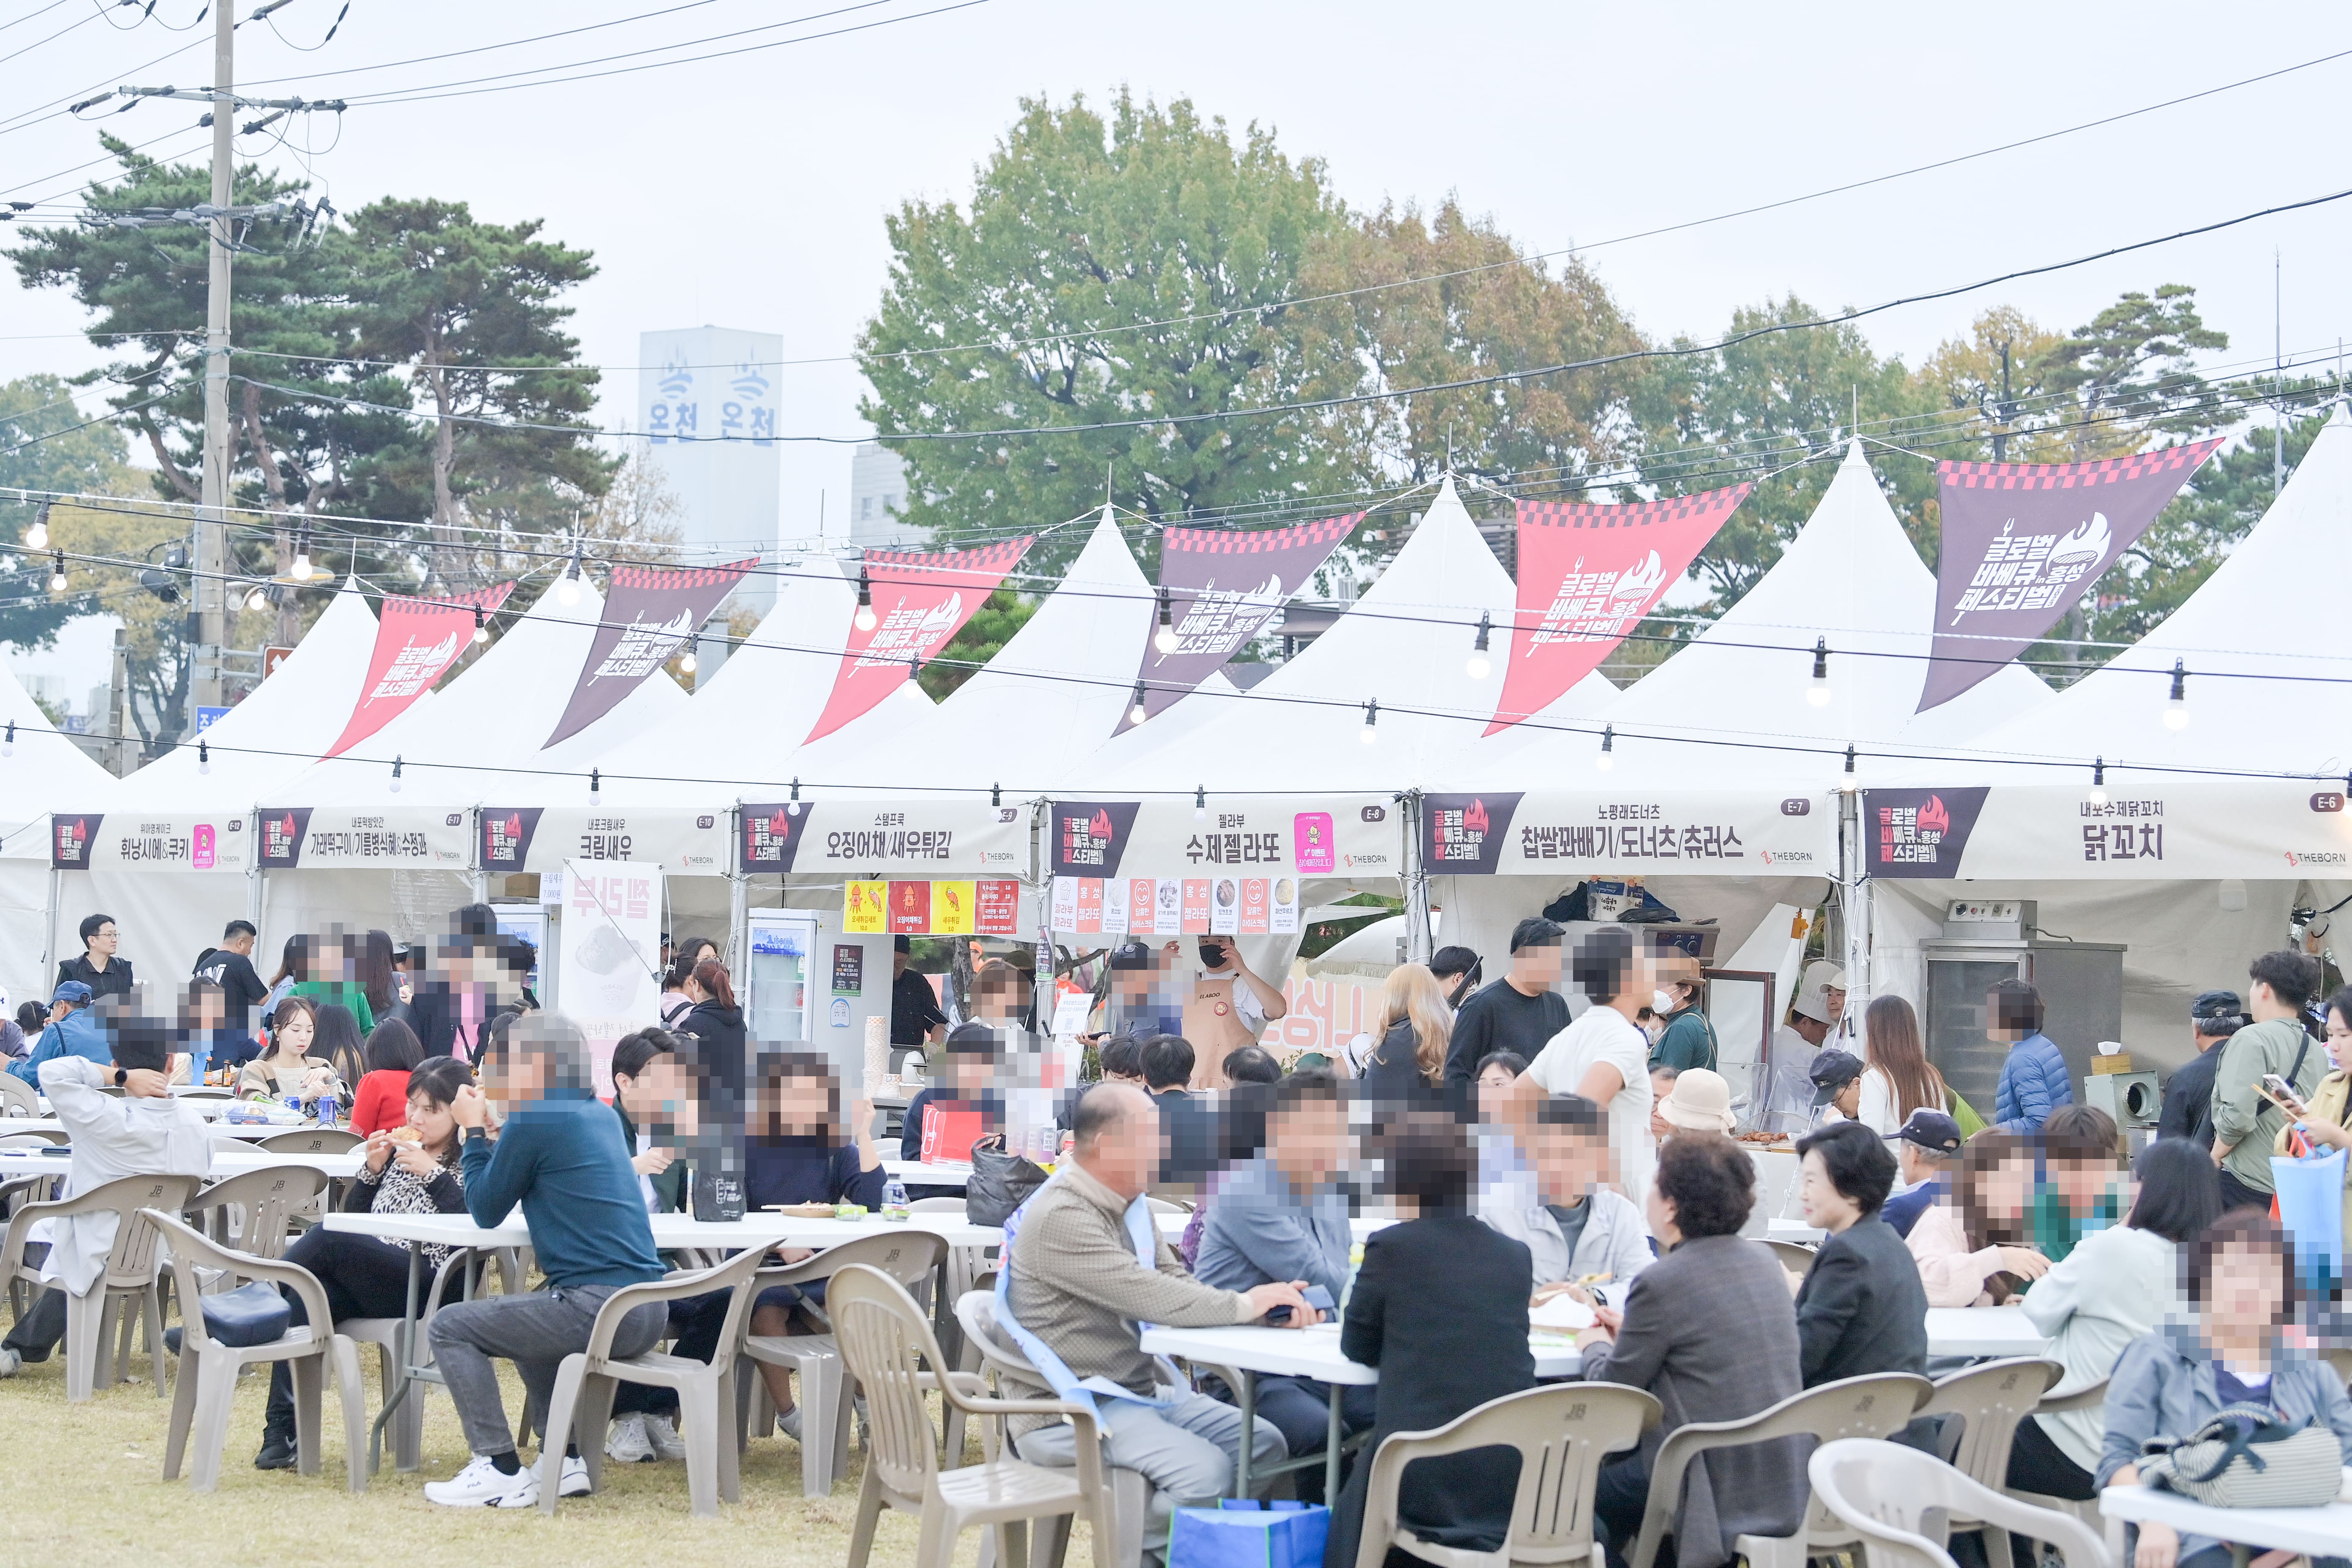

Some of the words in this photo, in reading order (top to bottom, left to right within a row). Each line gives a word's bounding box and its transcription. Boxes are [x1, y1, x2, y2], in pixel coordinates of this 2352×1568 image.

[650, 403, 697, 444] 온천
[721, 401, 774, 447] 온천
[1984, 534, 2058, 562] 글로벌
[1970, 561, 2043, 587] 바베큐
[2045, 563, 2087, 585] 홍성
[1557, 571, 1619, 597] 글로벌
[1188, 593, 1242, 615] 글로벌
[1954, 585, 2054, 612] 페스티벌
[1544, 597, 1607, 620] 바베큐
[1607, 600, 1643, 619] 홍성
[881, 608, 928, 629] 글로벌
[1175, 615, 1229, 635] 바베큐
[1228, 617, 1260, 633] 홍성
[868, 630, 915, 648] 바베큐
[913, 632, 942, 646] 홍성
[1530, 620, 1617, 644] 페스티벌
[394, 646, 432, 664] 글로벌
[608, 642, 647, 659] 바베큐
[648, 645, 673, 659] 홍성
[382, 664, 421, 681] 바베큐
[417, 666, 438, 680] 홍성
[593, 659, 648, 676] 페스티벌
[370, 680, 418, 698] 페스티벌
[1787, 801, 1802, 813] E-7
[2080, 800, 2164, 818] 내포수제닭꼬치
[2318, 797, 2336, 809] E-6
[448, 816, 460, 825] E-11
[874, 813, 904, 826] 스탬프쿡
[1002, 811, 1013, 820] E-9
[1219, 814, 1245, 829] 젤라부
[1367, 809, 1379, 819] E-8
[1435, 810, 1463, 826] 글로벌
[1879, 807, 1916, 825] 글로벌
[141, 823, 171, 834] 위아영케이크
[229, 822, 240, 830] E-12
[352, 817, 384, 828] 내포떡방앗간
[486, 820, 505, 833] 글로벌
[588, 818, 625, 831] 내포크림새우
[699, 818, 711, 827] E-10
[747, 818, 769, 832] 글로벌
[1064, 817, 1089, 833] 글로벌
[487, 834, 505, 847] 바베큐
[506, 838, 517, 847] 홍성
[747, 833, 770, 847] 바베큐
[773, 835, 784, 846] 홍성
[1064, 833, 1090, 849] 바베큐
[1093, 837, 1106, 849] 홍성
[1435, 827, 1463, 843] 바베큐
[1467, 831, 1483, 843] 홍성
[1522, 825, 1742, 859] 찹쌀꽈배기/도너츠/츄러스
[1881, 826, 1916, 843] 바베큐
[1921, 830, 1940, 844] 홍성
[121, 838, 189, 860] 휘낭시에&쿠키
[580, 835, 632, 861] 크림새우
[827, 830, 952, 859] 오징어채/새우튀김
[1187, 833, 1280, 864] 수제젤라또
[2083, 824, 2163, 862] 닭꼬치
[488, 847, 512, 860] 페스티벌
[748, 847, 776, 860] 페스티벌
[1064, 849, 1099, 864] 페스티벌
[1311, 849, 1326, 857] 이벤트
[1435, 844, 1474, 860] 페스티벌
[1773, 852, 1812, 860] THEBORN
[1881, 844, 1930, 863] 페스티벌
[2297, 853, 2346, 862] THEBORN
[543, 873, 563, 884] 크림새우
[1055, 904, 1073, 915] 젤라부
[1078, 908, 1100, 920] 젤라또
[1135, 908, 1149, 916] 달콤한
[1184, 907, 1207, 920] 젤라또
[1247, 906, 1262, 915] 달콤한
[897, 916, 922, 924] 오징어채튀김
[943, 916, 960, 924] 새우튀김
[1054, 917, 1073, 928] 젤라또
[1132, 920, 1153, 928] 아이스크림
[1242, 919, 1266, 928] 아이스크림
[151, 1185, 163, 1194] JB
[273, 1180, 285, 1188] JB
